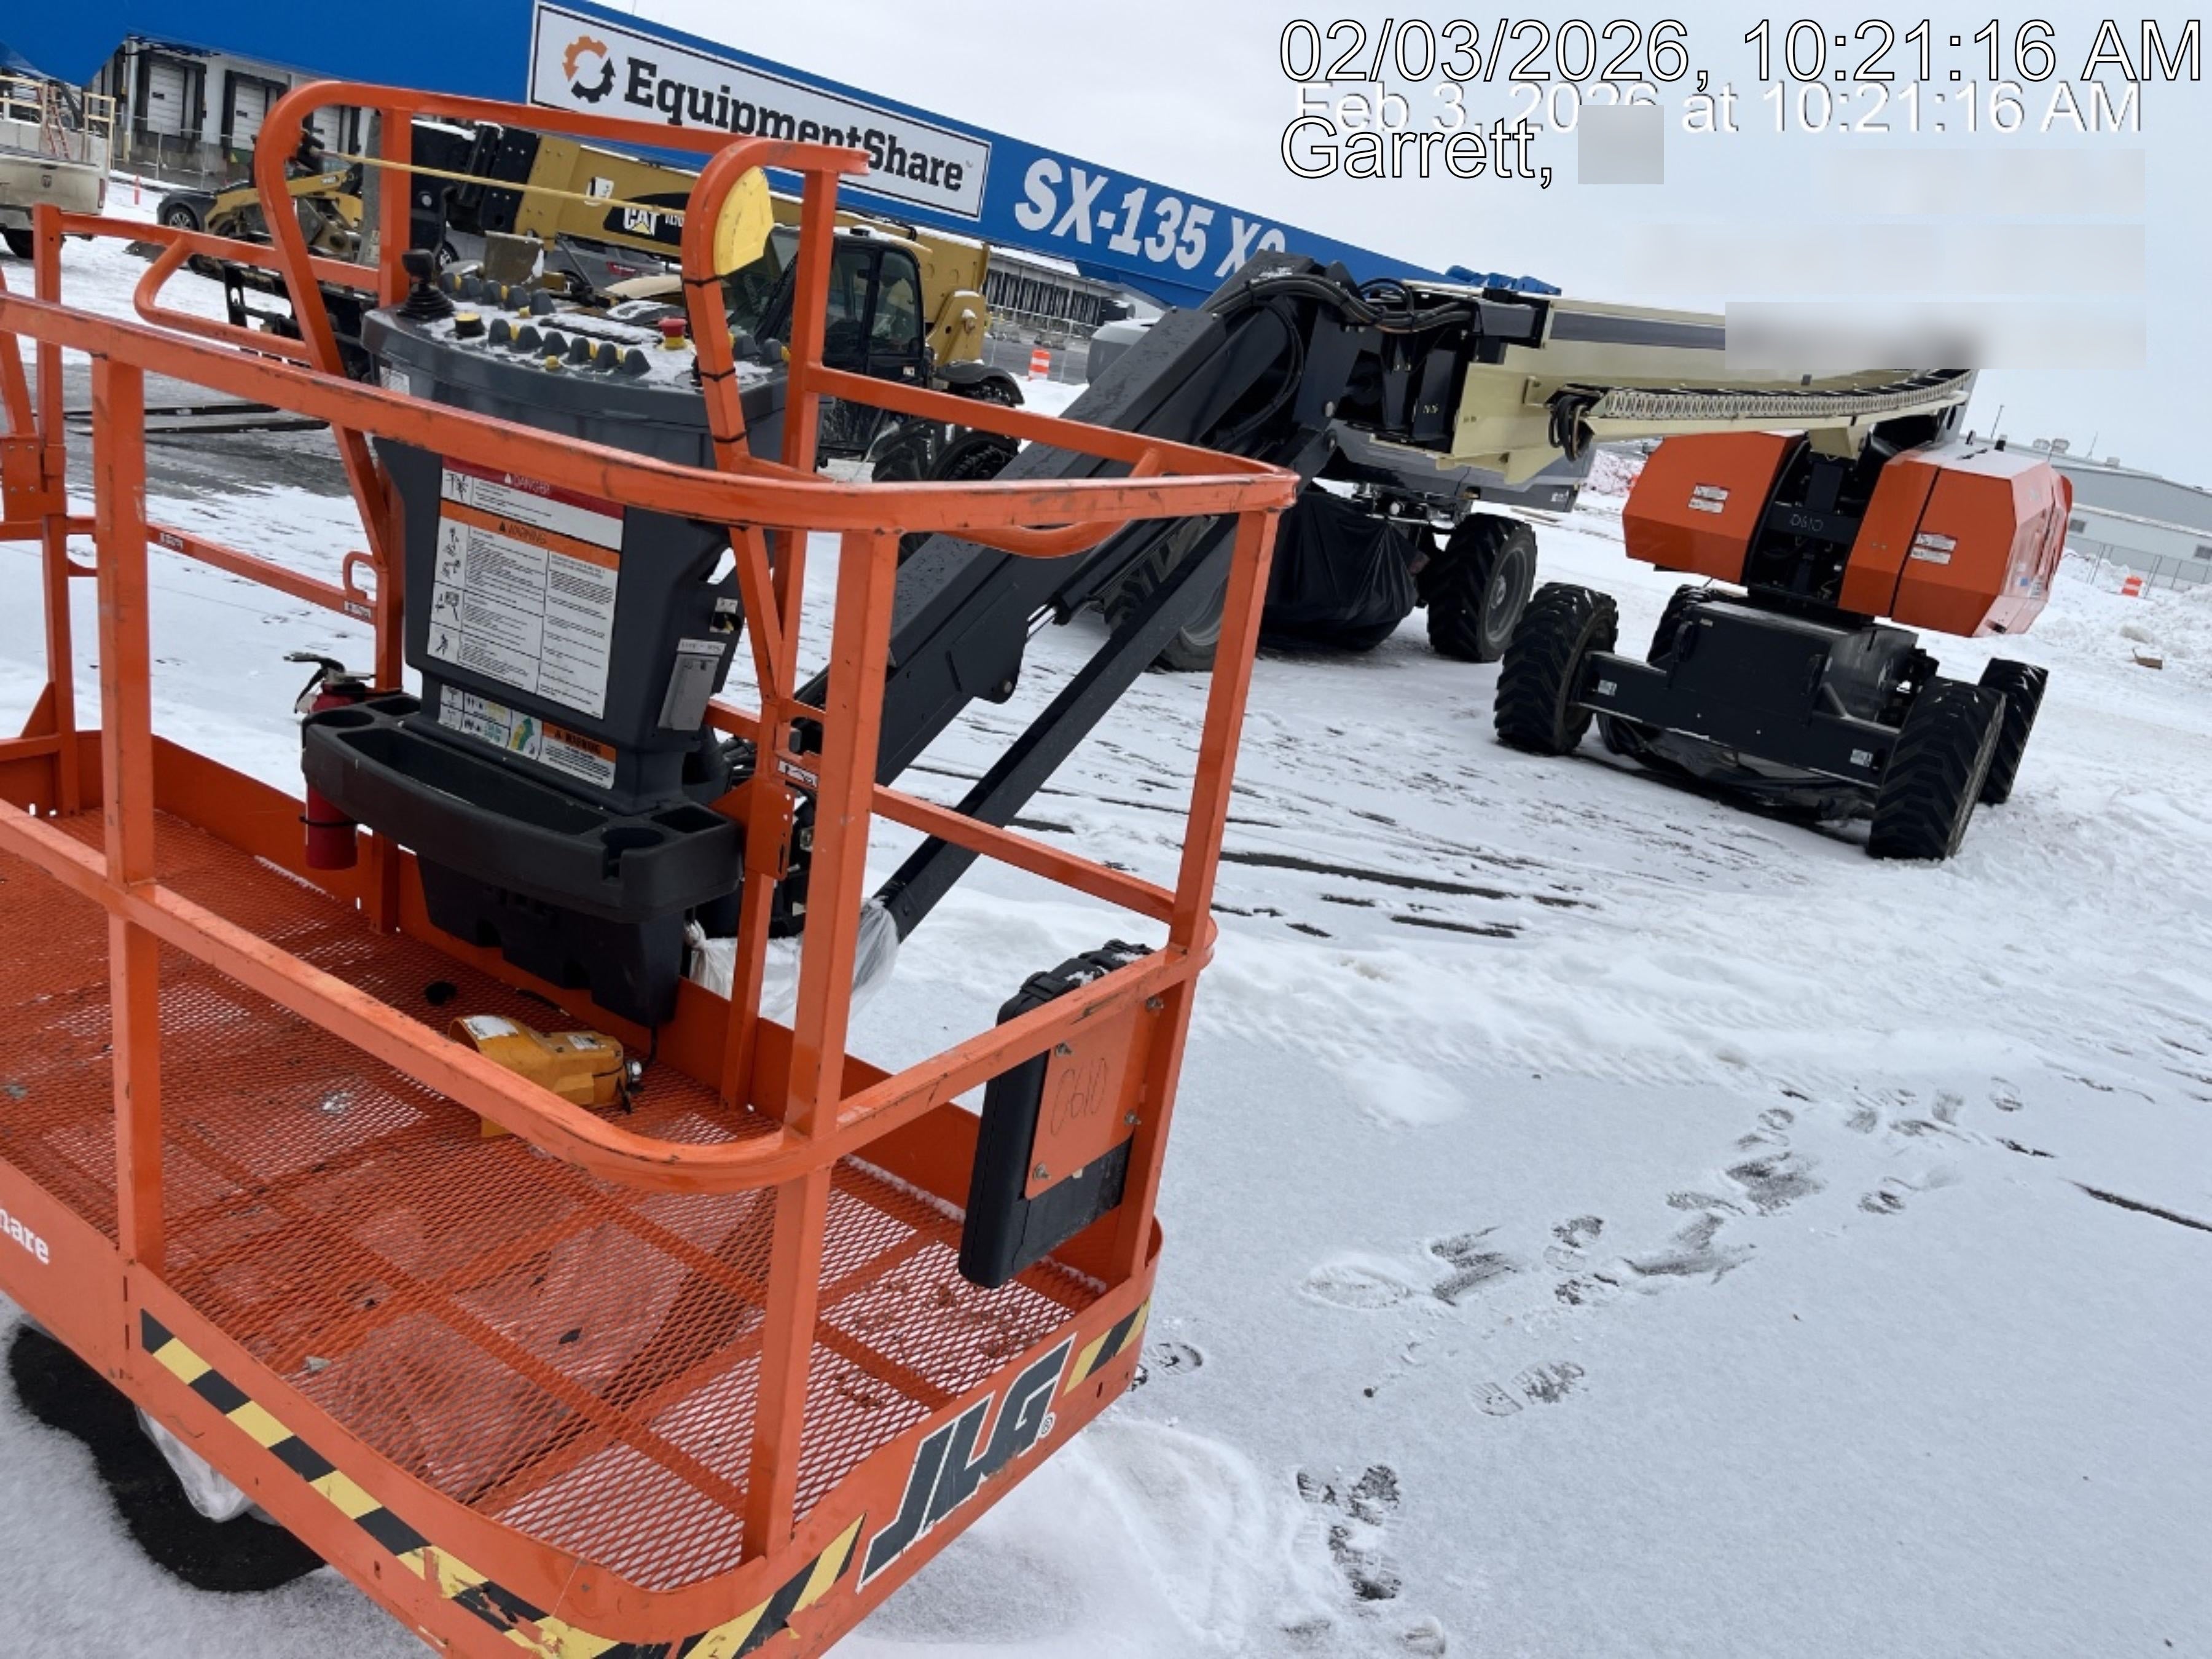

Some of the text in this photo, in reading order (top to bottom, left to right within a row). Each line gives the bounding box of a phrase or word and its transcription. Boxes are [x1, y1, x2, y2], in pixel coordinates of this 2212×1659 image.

[624, 57, 963, 192] EquipmentShare
[624, 206, 661, 236] CAT
[1014, 158, 1215, 270] SX-135
[509, 524, 547, 545] WARNING
[857, 1332, 1078, 1594] JLG
